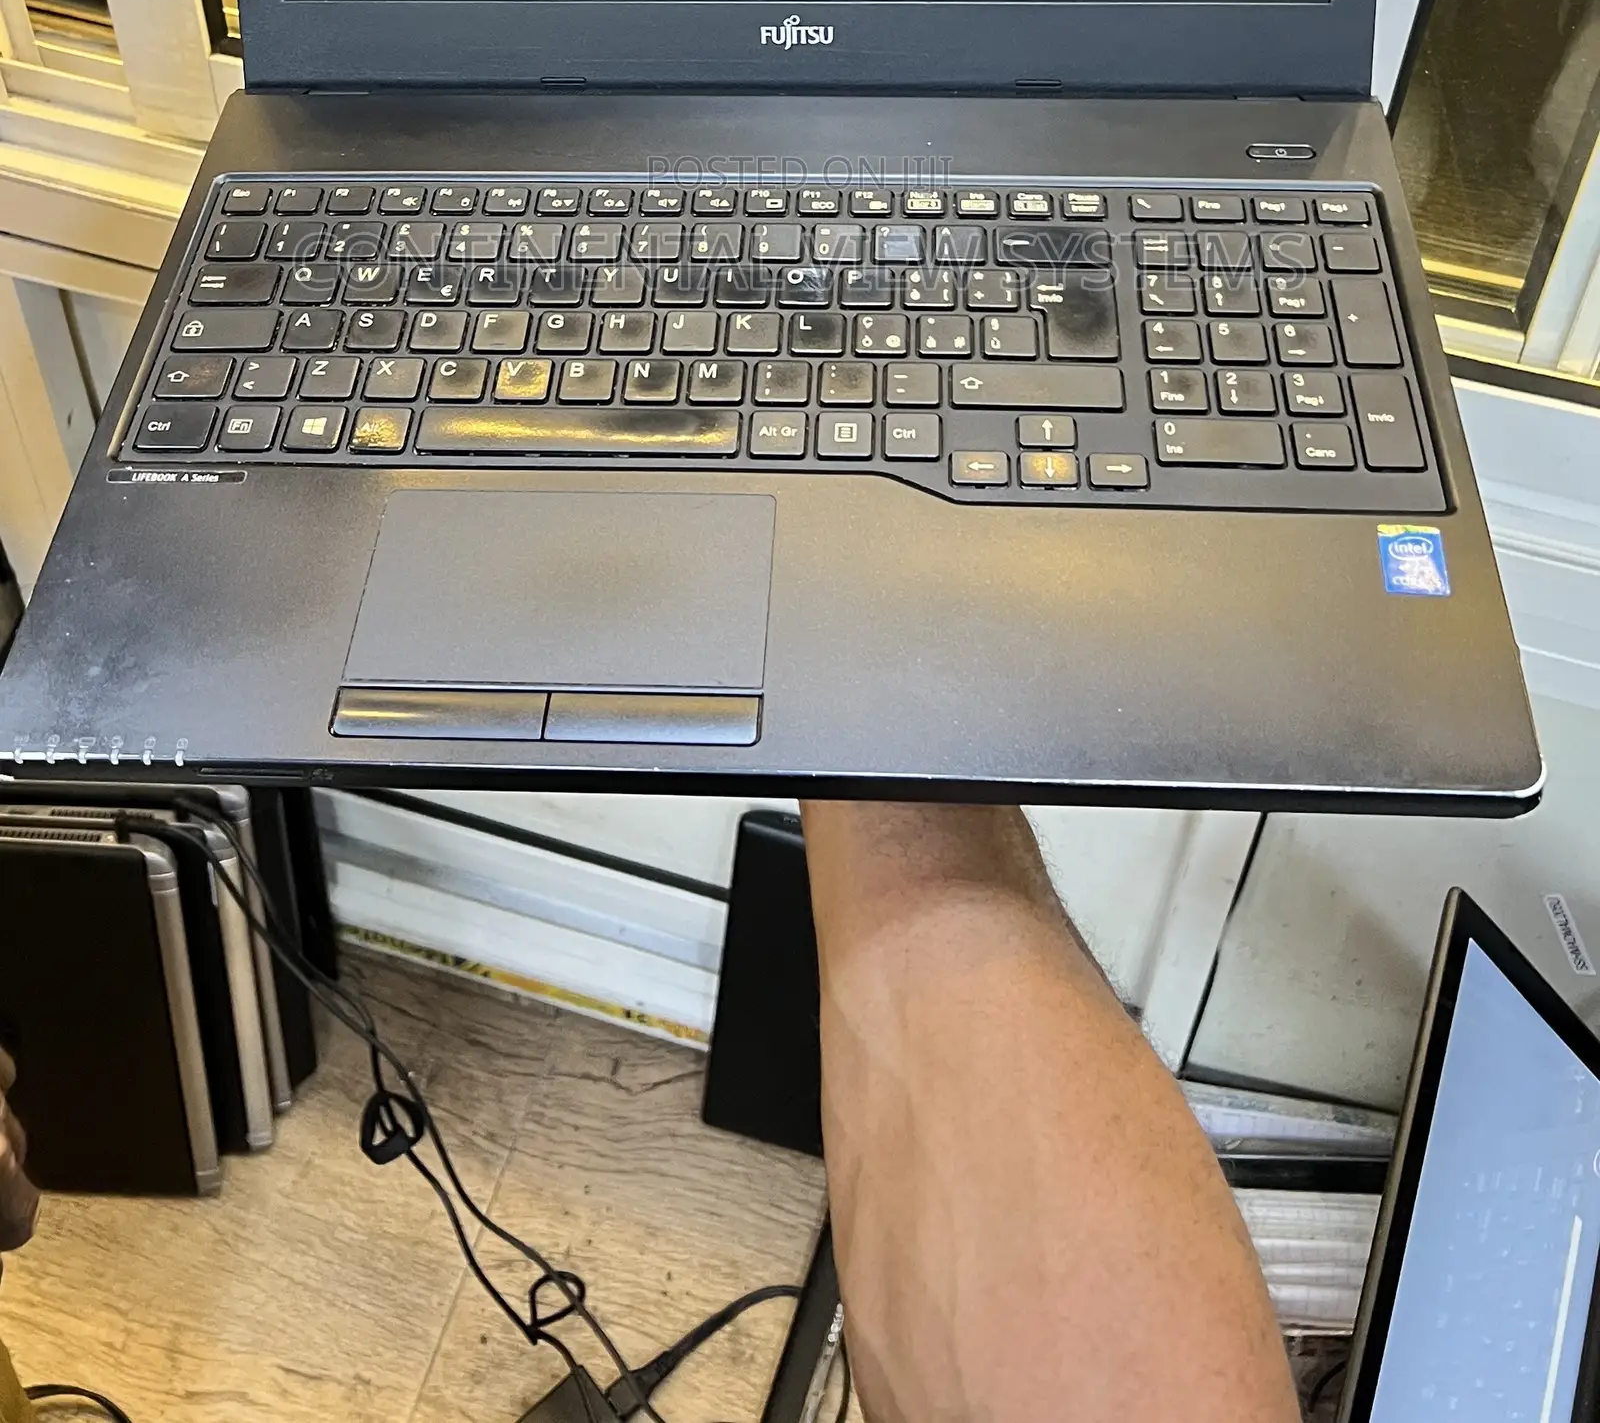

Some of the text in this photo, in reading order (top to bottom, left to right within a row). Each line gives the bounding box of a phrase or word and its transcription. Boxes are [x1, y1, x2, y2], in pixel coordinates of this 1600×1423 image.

[760, 15, 834, 50] FUJITSU
[751, 190, 770, 198] F10
[803, 190, 820, 198] F11
[855, 191, 873, 199] F12
[811, 201, 835, 209] ECO
[277, 241, 284, 251] 1
[334, 241, 345, 252] 2
[395, 241, 405, 252] 3
[455, 242, 465, 252] 4
[638, 241, 648, 252] 7
[698, 241, 708, 253] 8
[759, 242, 769, 253] 9
[819, 243, 829, 254] 0
[295, 268, 312, 282] Q
[358, 267, 380, 282] W
[417, 268, 432, 282] E
[479, 268, 495, 282] R
[542, 268, 557, 283] T
[603, 268, 619, 283] Y
[664, 268, 679, 283] U
[726, 268, 733, 283] I
[787, 268, 804, 284] O
[848, 270, 863, 284] P
[1147, 275, 1158, 287] 7
[441, 284, 452, 297] €
[295, 313, 311, 327] A
[358, 313, 374, 328] S
[420, 313, 437, 328] D
[484, 313, 498, 328] F
[547, 314, 564, 329] G
[609, 314, 626, 329] H
[672, 315, 684, 329] J
[736, 315, 752, 330] K
[799, 316, 812, 330] L
[1153, 322, 1164, 334] 4
[1218, 323, 1230, 335] 5
[1284, 325, 1296, 337] 6
[311, 361, 329, 376] Z
[376, 361, 394, 376] X
[440, 361, 457, 376] C
[507, 361, 522, 376] V
[569, 362, 585, 378] B
[634, 362, 651, 378] N
[698, 363, 718, 379] M
[1160, 371, 1169, 384] 1
[1226, 372, 1237, 385] 2
[1293, 374, 1305, 387] 3
[1160, 392, 1185, 402] Fine
[148, 422, 171, 432] Ctrl
[231, 422, 249, 431] Fn
[759, 427, 798, 437] Alt Gr
[1164, 422, 1176, 435] 0
[892, 429, 916, 439] Ctrl
[131, 473, 219, 482] LIFEBOOK A Series
